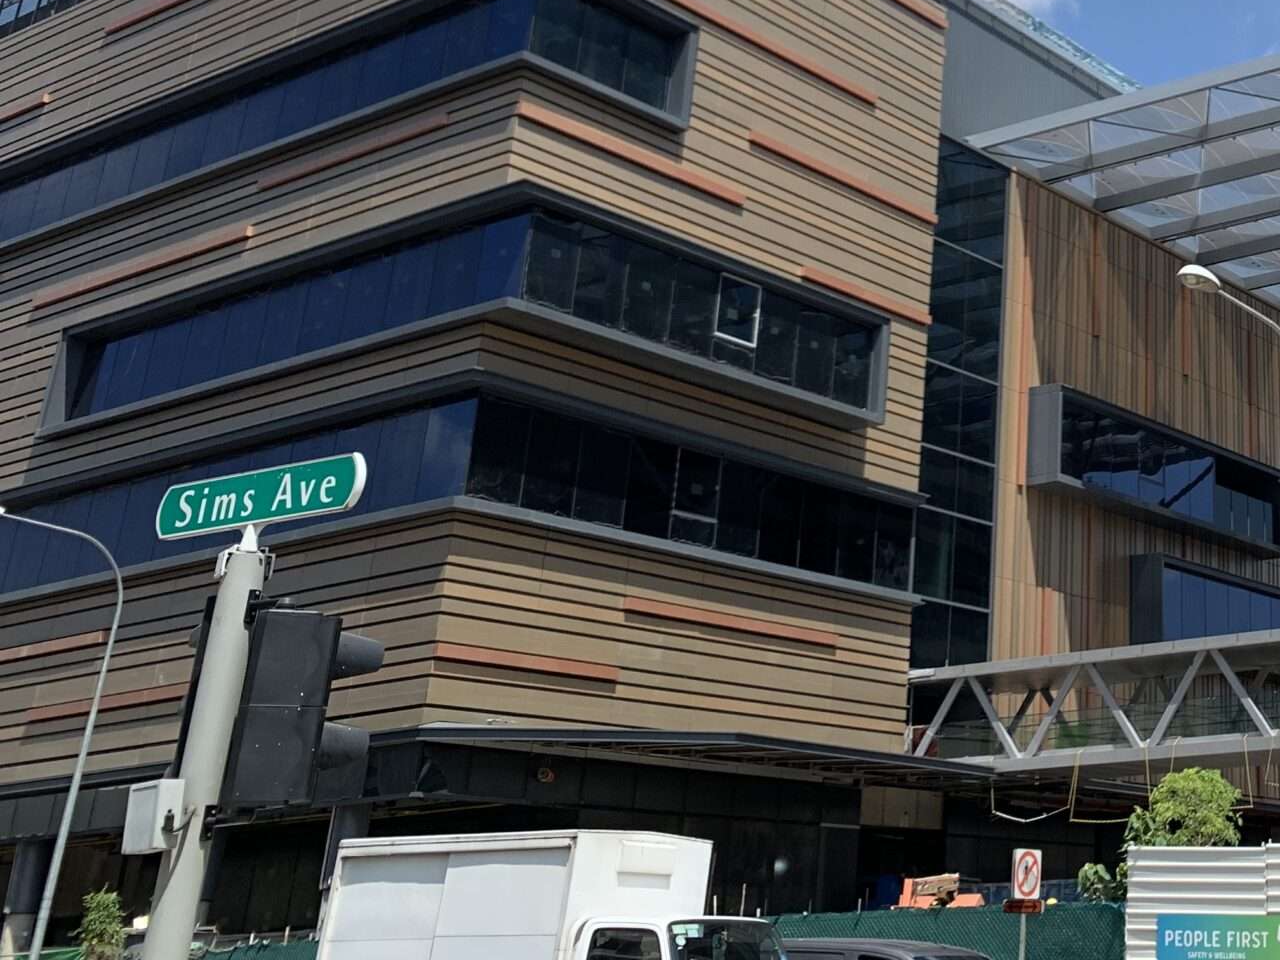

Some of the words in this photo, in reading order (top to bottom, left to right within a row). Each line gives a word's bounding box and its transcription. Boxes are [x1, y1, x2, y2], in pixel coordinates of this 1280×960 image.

[175, 487, 255, 528] Sims
[270, 472, 337, 512] Ave
[1164, 929, 1221, 948] PEOPLE
[1226, 931, 1270, 948] FIRST
